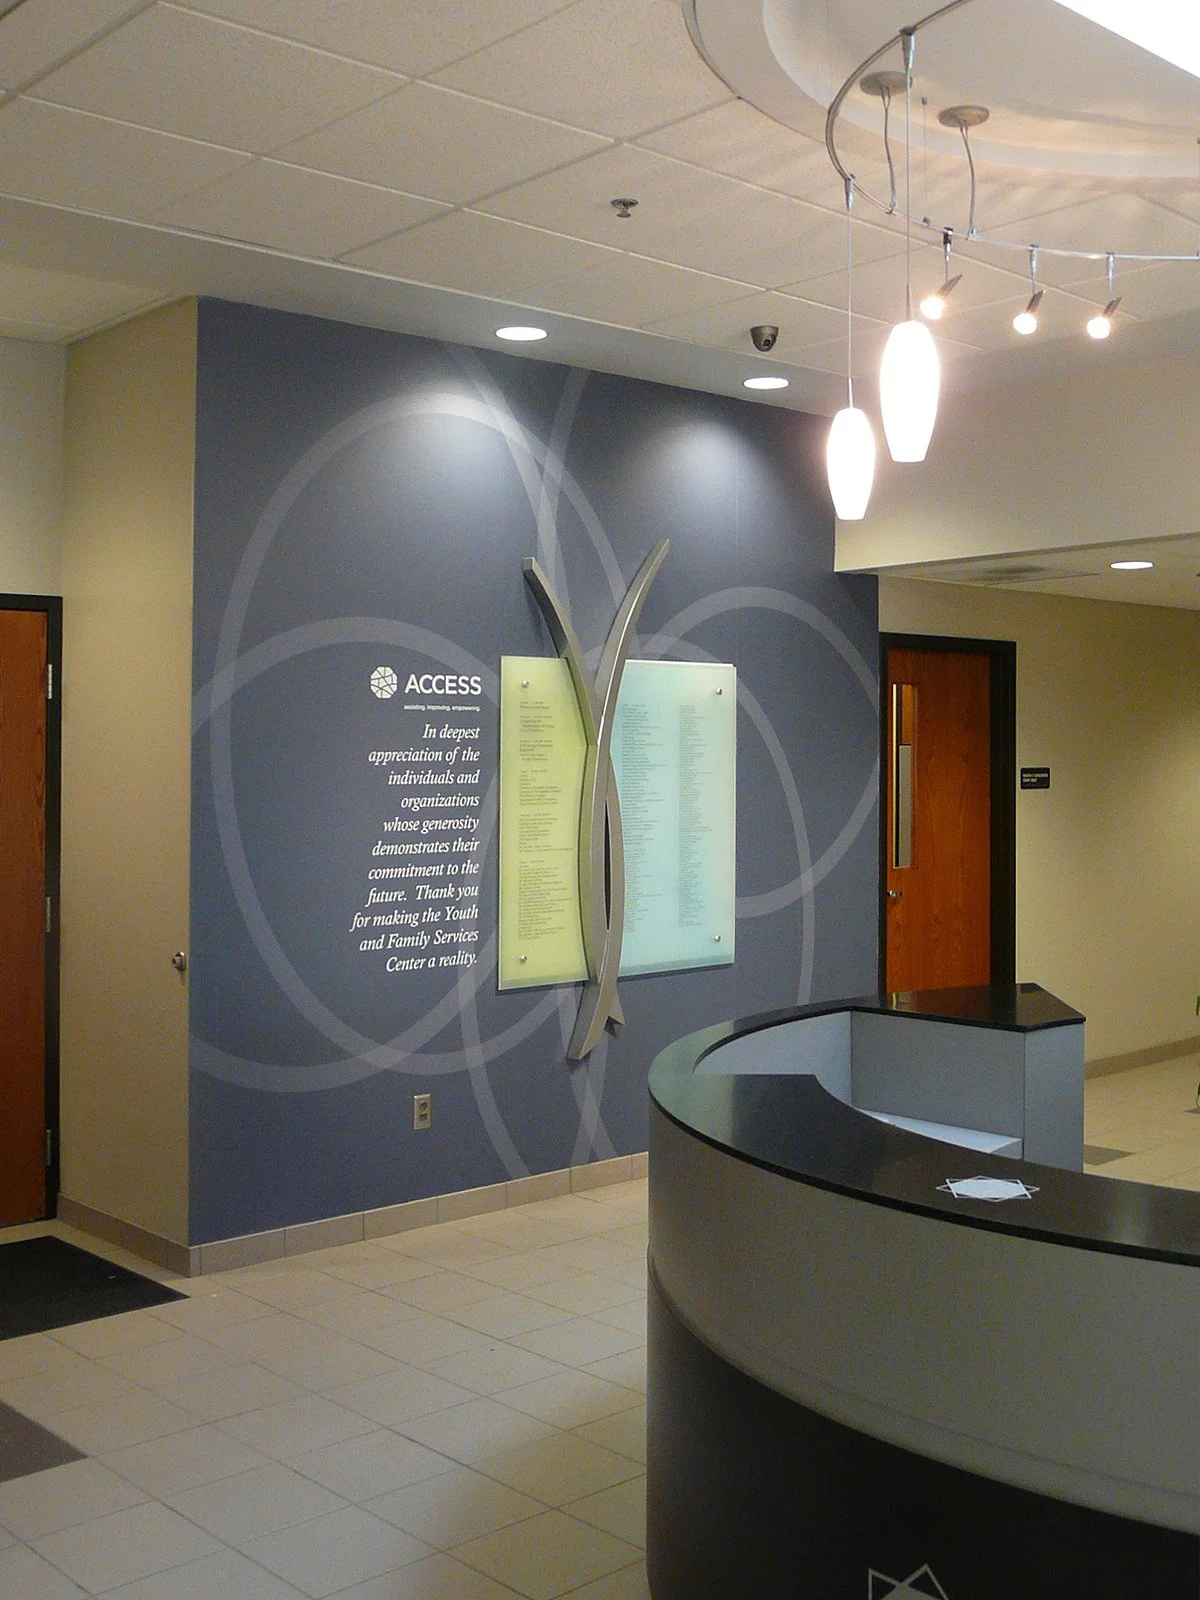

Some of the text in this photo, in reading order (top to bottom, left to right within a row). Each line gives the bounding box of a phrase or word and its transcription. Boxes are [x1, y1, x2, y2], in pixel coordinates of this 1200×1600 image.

[405, 674, 482, 695] ACCESS
[422, 724, 481, 741] In deepest
[369, 746, 480, 765] appreciation of the
[388, 769, 480, 785] individuals and
[401, 793, 480, 811] organizations
[383, 815, 479, 834] whose generosity
[372, 838, 480, 856] demonstrates their
[369, 860, 480, 880] commitment to the
[366, 884, 479, 907] future. Thank you
[350, 904, 479, 932] for making the Youth
[359, 927, 479, 951] and Family Services
[386, 951, 478, 972] Center a reality.
